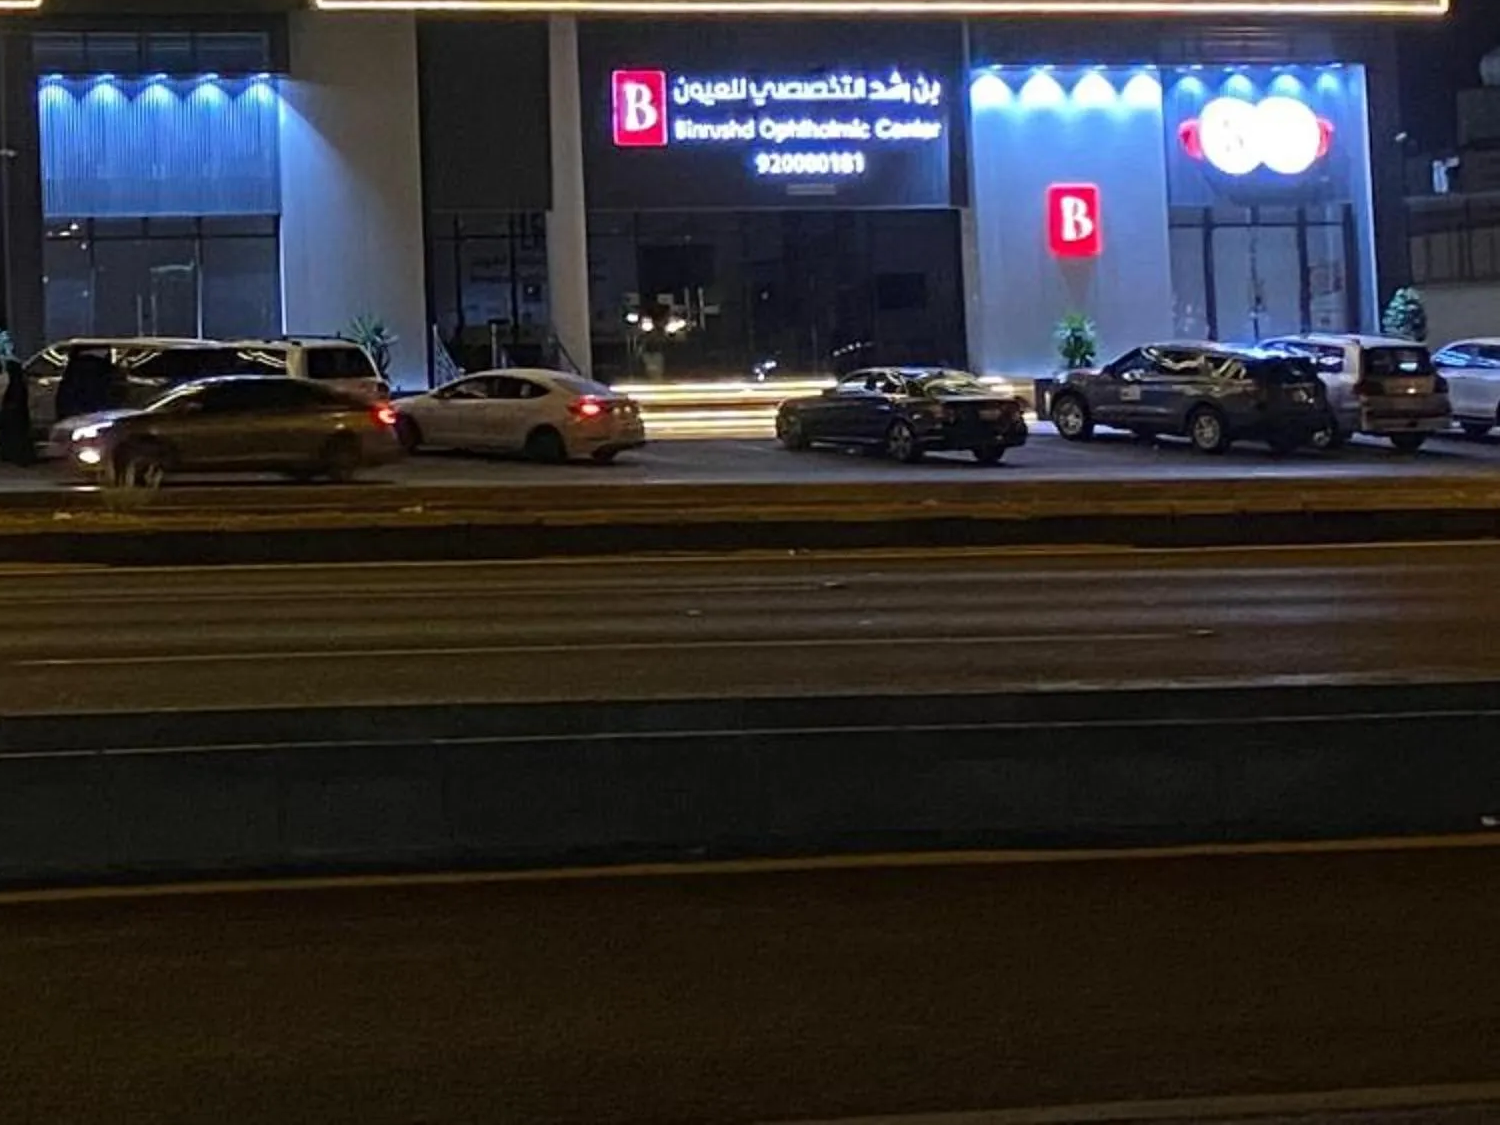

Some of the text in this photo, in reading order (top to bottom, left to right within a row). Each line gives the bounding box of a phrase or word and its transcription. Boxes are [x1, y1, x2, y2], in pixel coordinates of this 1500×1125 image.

[622, 81, 658, 132] B
[673, 76, 747, 106] للعيون
[749, 74, 867, 107] التخصصي
[911, 74, 941, 106] بن
[1060, 195, 1094, 242] B
